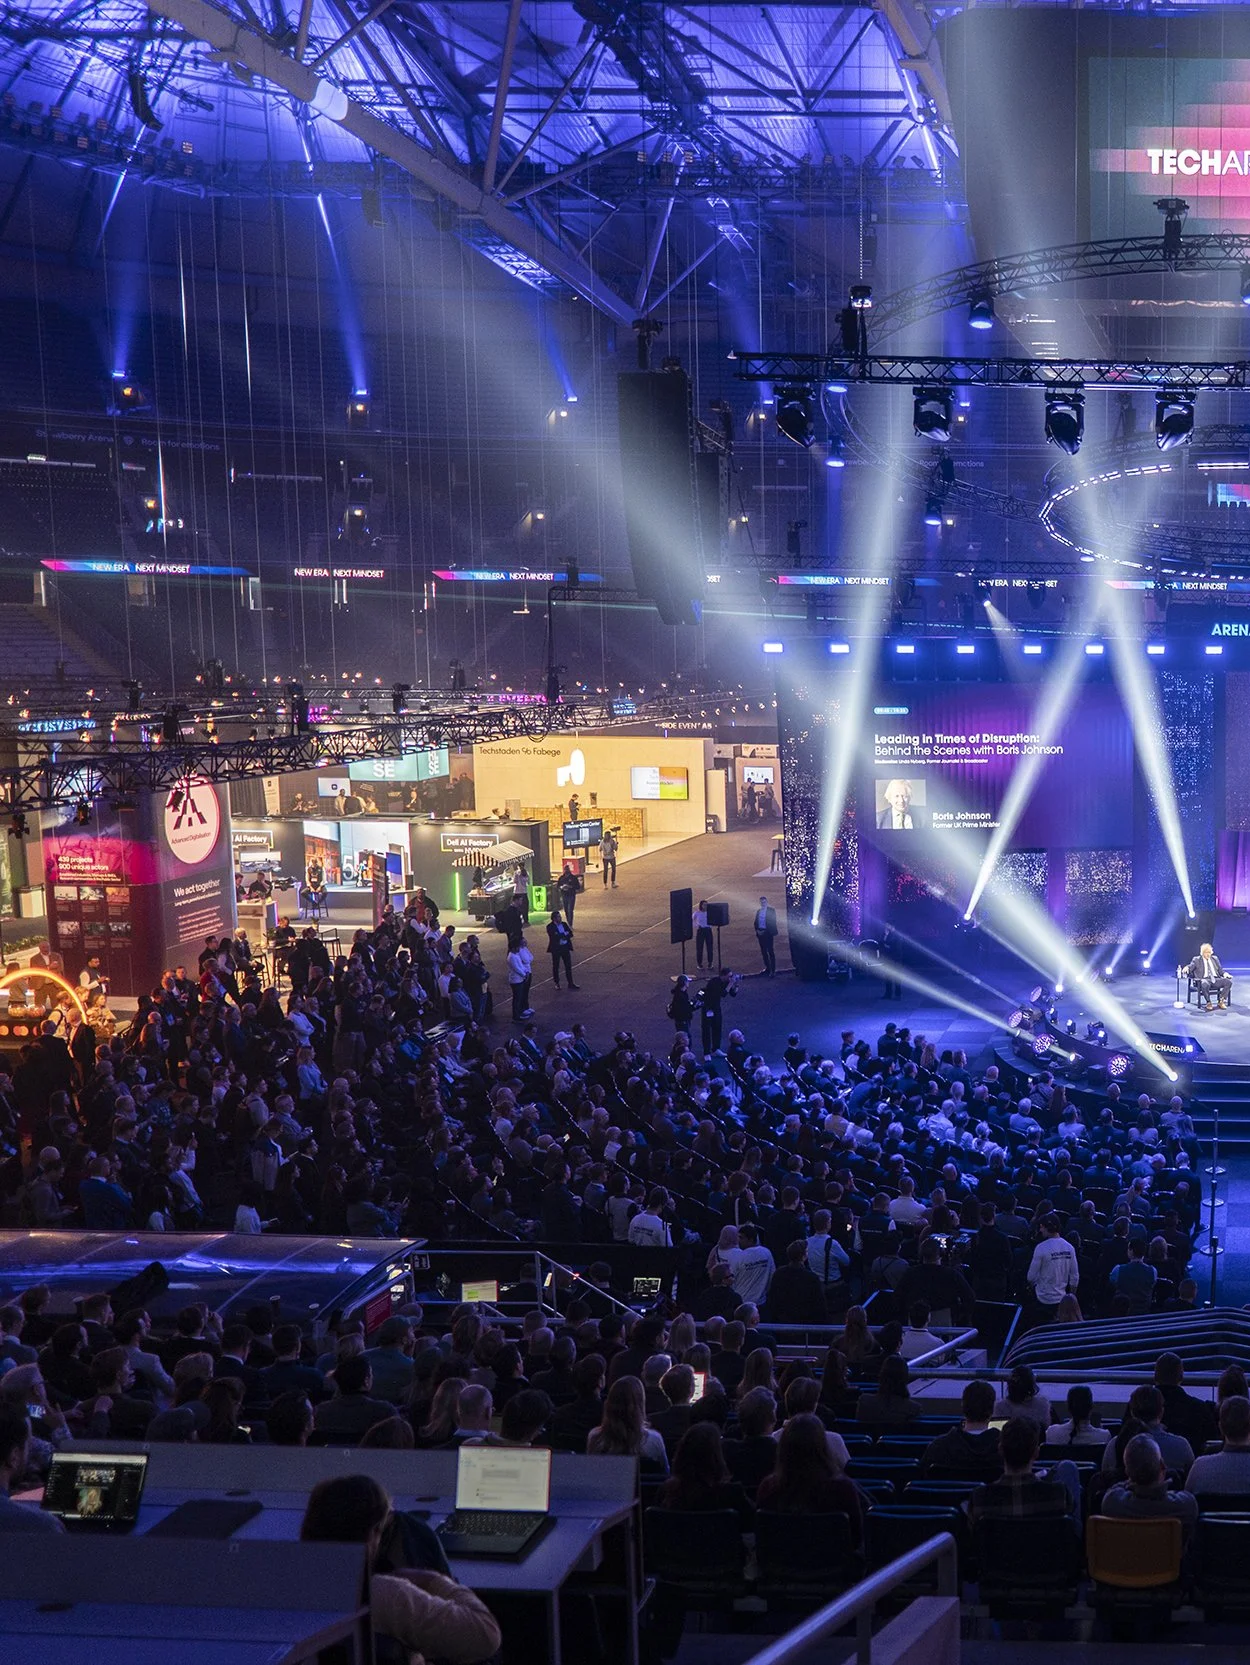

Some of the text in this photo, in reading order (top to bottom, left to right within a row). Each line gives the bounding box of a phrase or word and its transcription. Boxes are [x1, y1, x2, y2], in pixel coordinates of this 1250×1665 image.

[135, 563, 155, 574] NEXT
[156, 564, 190, 574] MINDSET
[294, 567, 384, 578] NEW ERA NEXT MINDSET
[526, 573, 554, 581] MINDSET
[844, 577, 860, 585] NEXT
[875, 733, 919, 746] Leading
[935, 733, 966, 744] Times
[969, 733, 980, 744] of
[982, 733, 1040, 745] Disruption:
[533, 747, 561, 758] Fabege
[875, 745, 1063, 756] Behind the Scenes with Boris Johnson
[932, 811, 991, 821] Boris Johnson
[235, 834, 267, 844] AI Factory
[468, 839, 493, 847] Factory
[70, 856, 93, 864] projects
[174, 886, 184, 897] We
[196, 879, 220, 893] together
